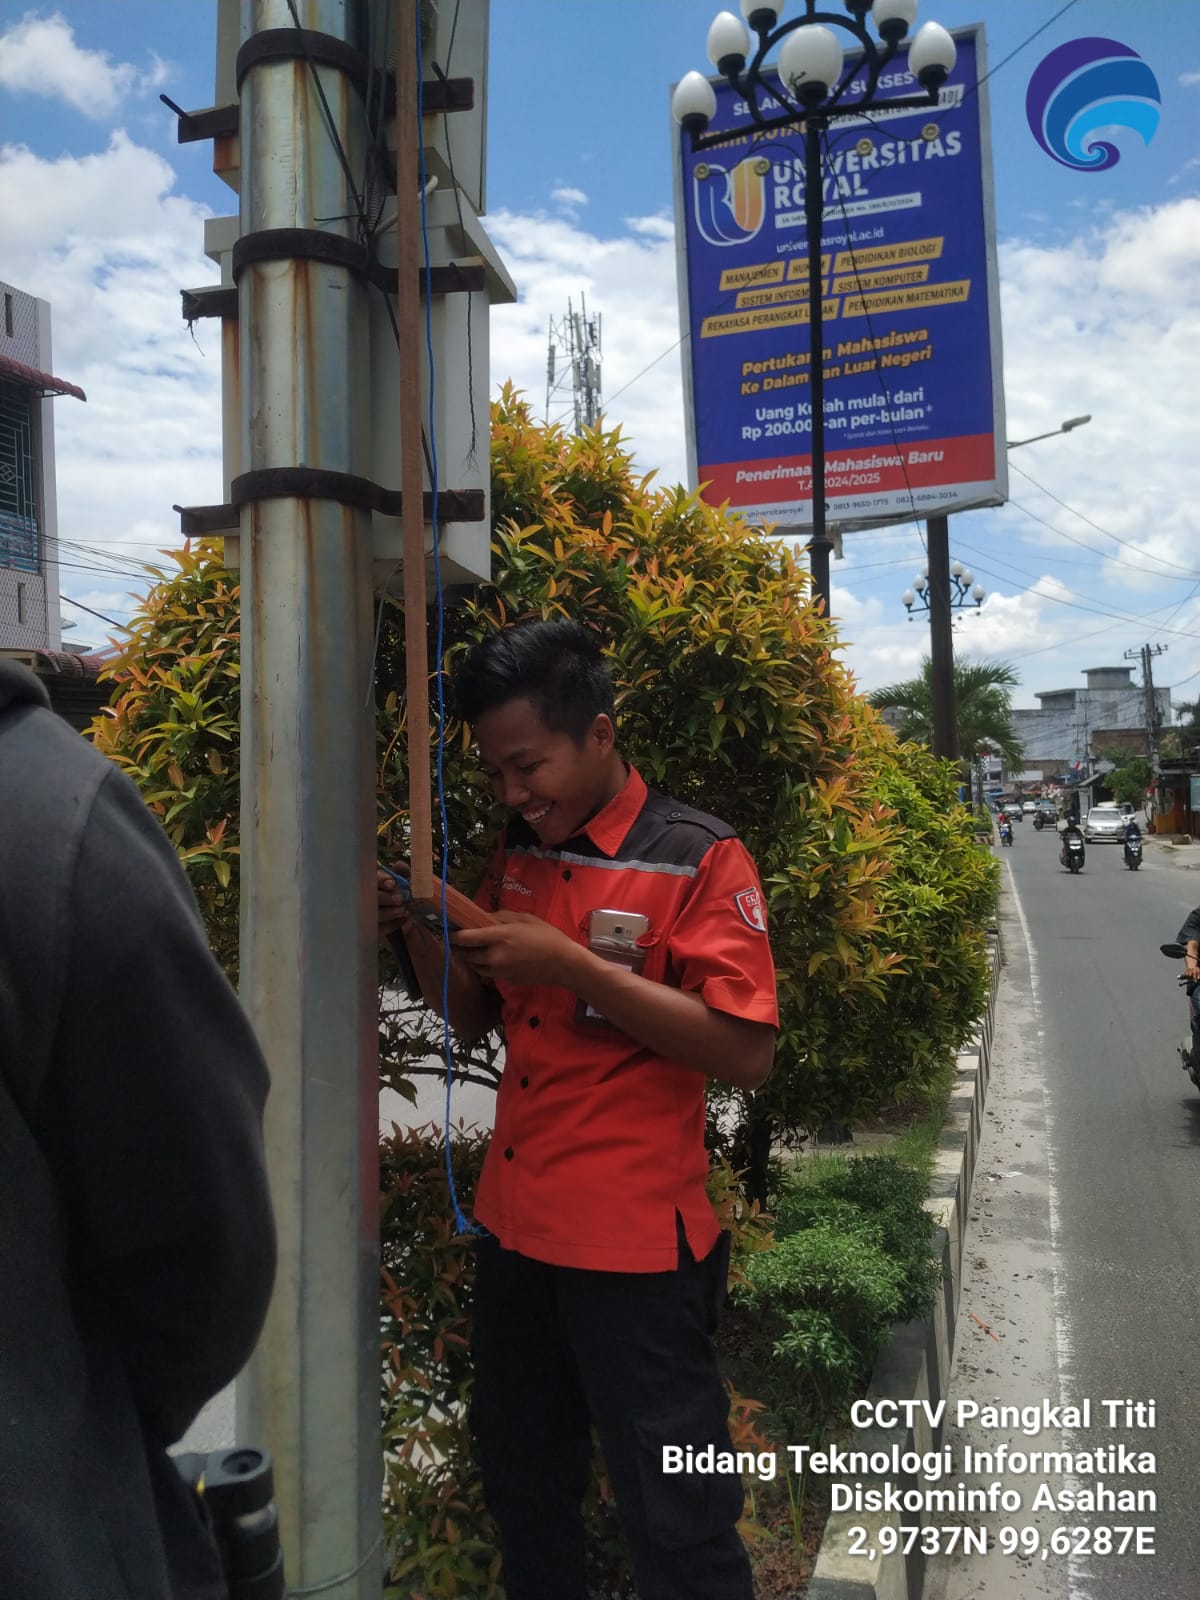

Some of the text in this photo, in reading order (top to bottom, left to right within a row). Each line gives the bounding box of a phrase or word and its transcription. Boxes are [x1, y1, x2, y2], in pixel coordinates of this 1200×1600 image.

[840, 243, 937, 266] PENDIDIKAN BIOLOGI
[726, 267, 779, 285] MANAJEMEN
[838, 271, 923, 293] SISTEM KOMPUTER
[741, 293, 773, 307] SISTEM
[848, 286, 965, 311] PENDIDIKAN MATEMATIKA
[707, 317, 750, 332] REKAYASA
[752, 309, 803, 325] PERANGKAT
[837, 328, 929, 357] Mahasiswa
[741, 344, 932, 395] Ke Dalam an Luar Negeri
[755, 406, 795, 421] Uang
[847, 390, 891, 410] mulai
[893, 386, 924, 405] dari
[742, 426, 762, 441] Rp
[736, 450, 944, 484] Penerimaa Mahasiswa Baru
